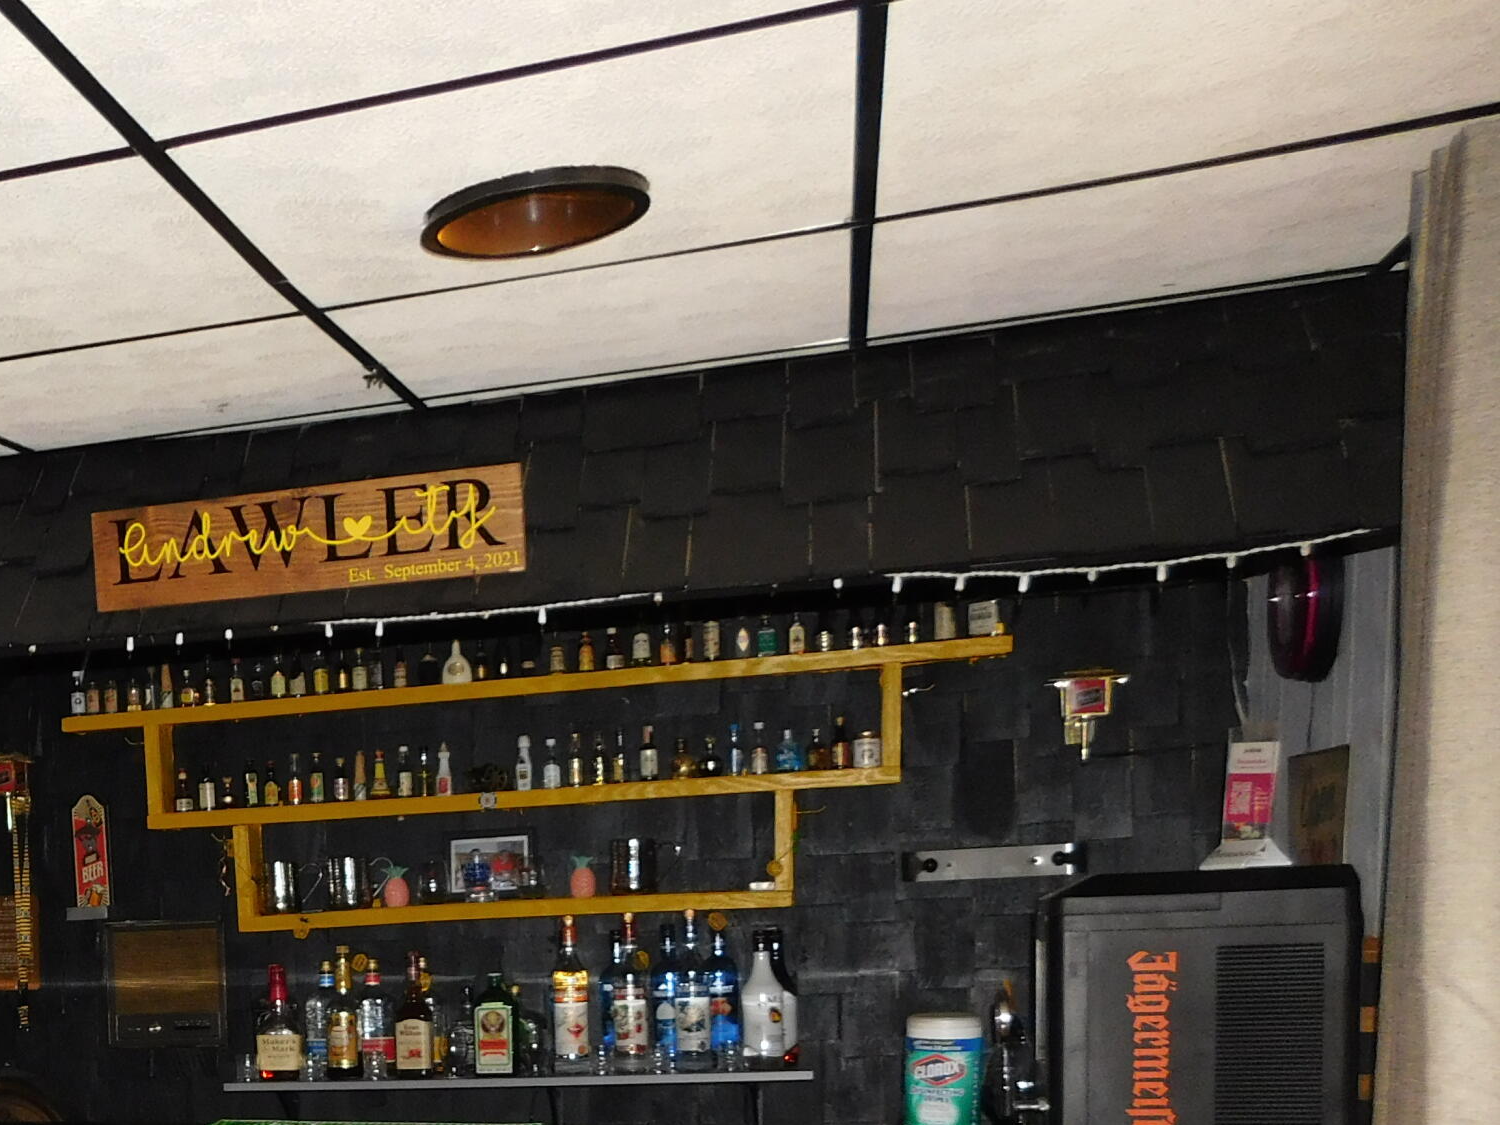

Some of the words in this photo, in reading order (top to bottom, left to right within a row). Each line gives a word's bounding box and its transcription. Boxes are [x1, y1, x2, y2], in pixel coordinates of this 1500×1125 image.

[108, 479, 507, 586] LAWLER
[349, 568, 376, 583] Est.
[384, 558, 462, 581] September
[465, 555, 480, 570] 4,
[484, 550, 521, 569] 2021
[82, 861, 104, 883] BEER
